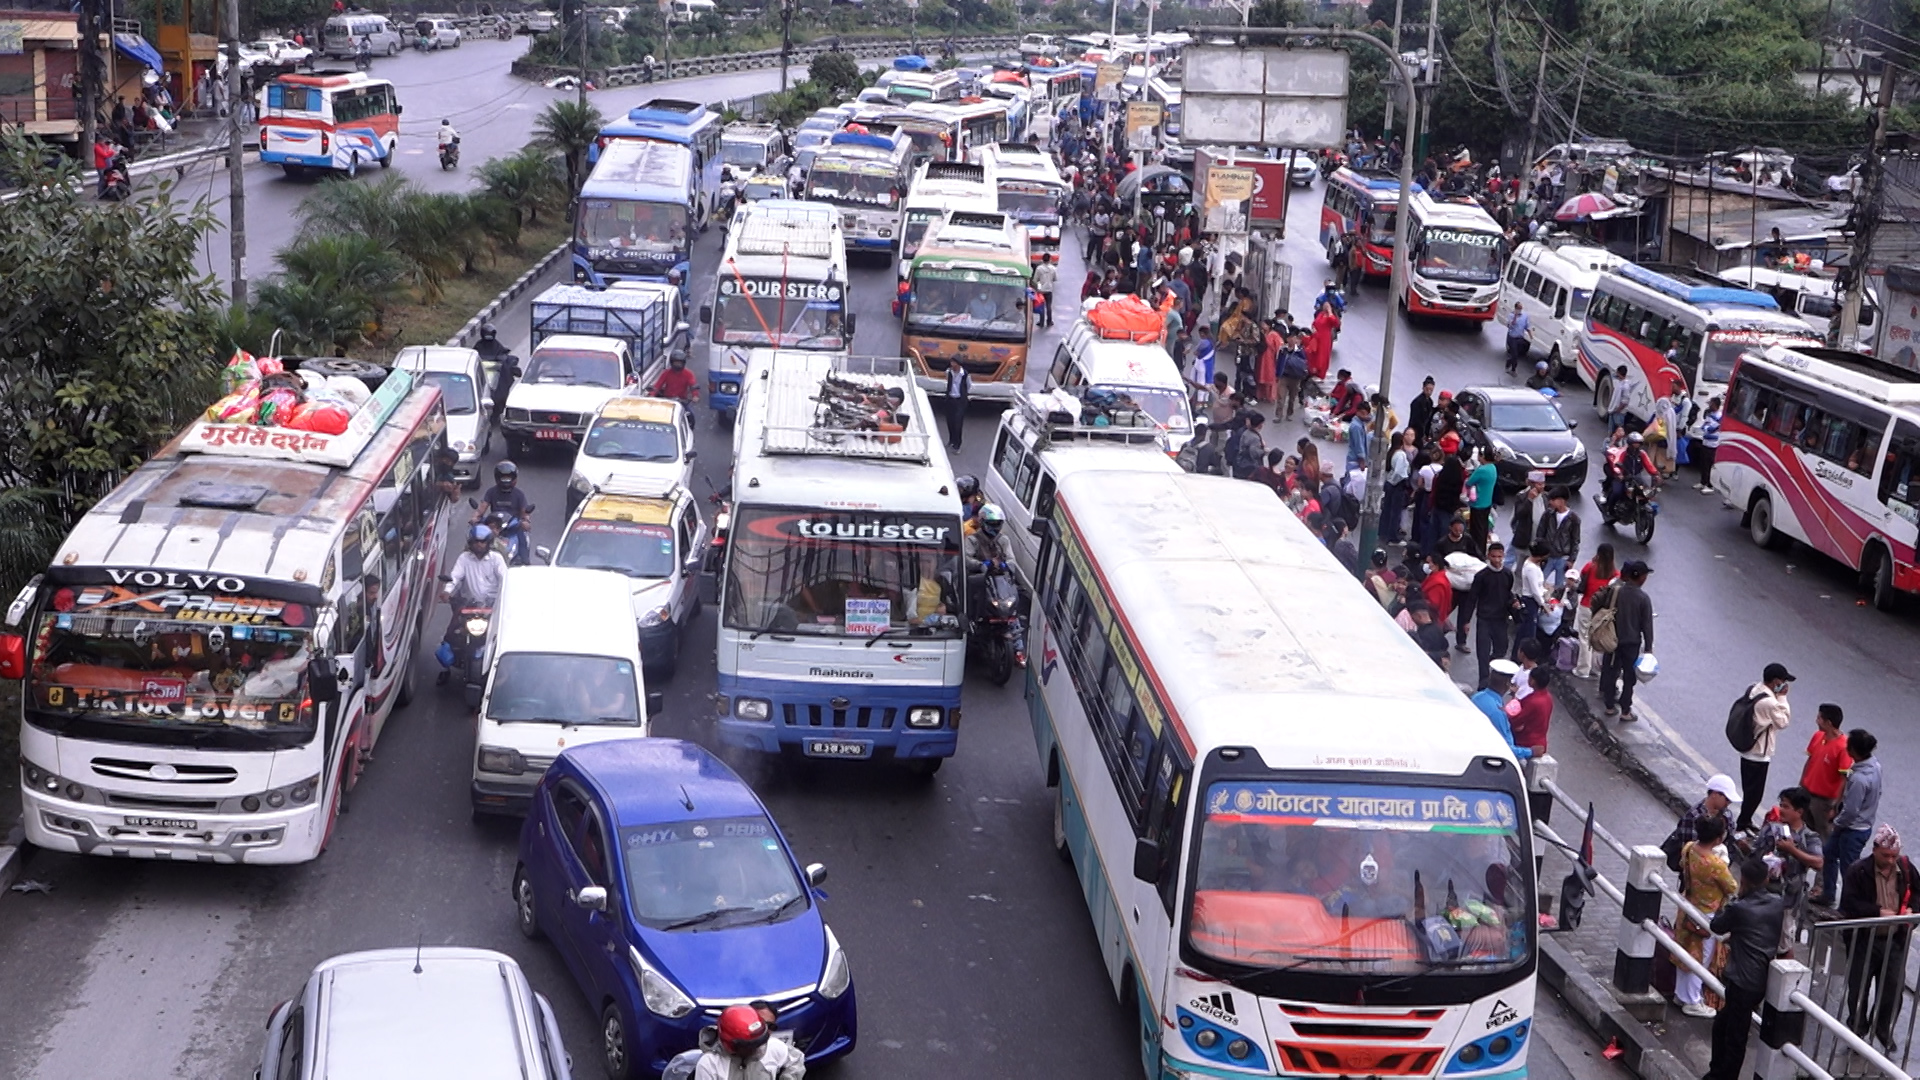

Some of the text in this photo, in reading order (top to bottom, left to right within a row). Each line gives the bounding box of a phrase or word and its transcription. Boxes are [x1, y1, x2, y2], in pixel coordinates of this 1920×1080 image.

[734, 279, 828, 298] TOURISTER
[797, 518, 950, 541] tourister
[106, 568, 246, 593] VOLVO
[77, 585, 287, 616] EXPRESS
[809, 667, 874, 679] Mahindra
[184, 695, 272, 721] Lover
[1256, 789, 1333, 816] गोठाटार
[1337, 796, 1416, 820] यातायात
[1190, 999, 1239, 1026] adidas
[1486, 1010, 1518, 1030] PEAK
